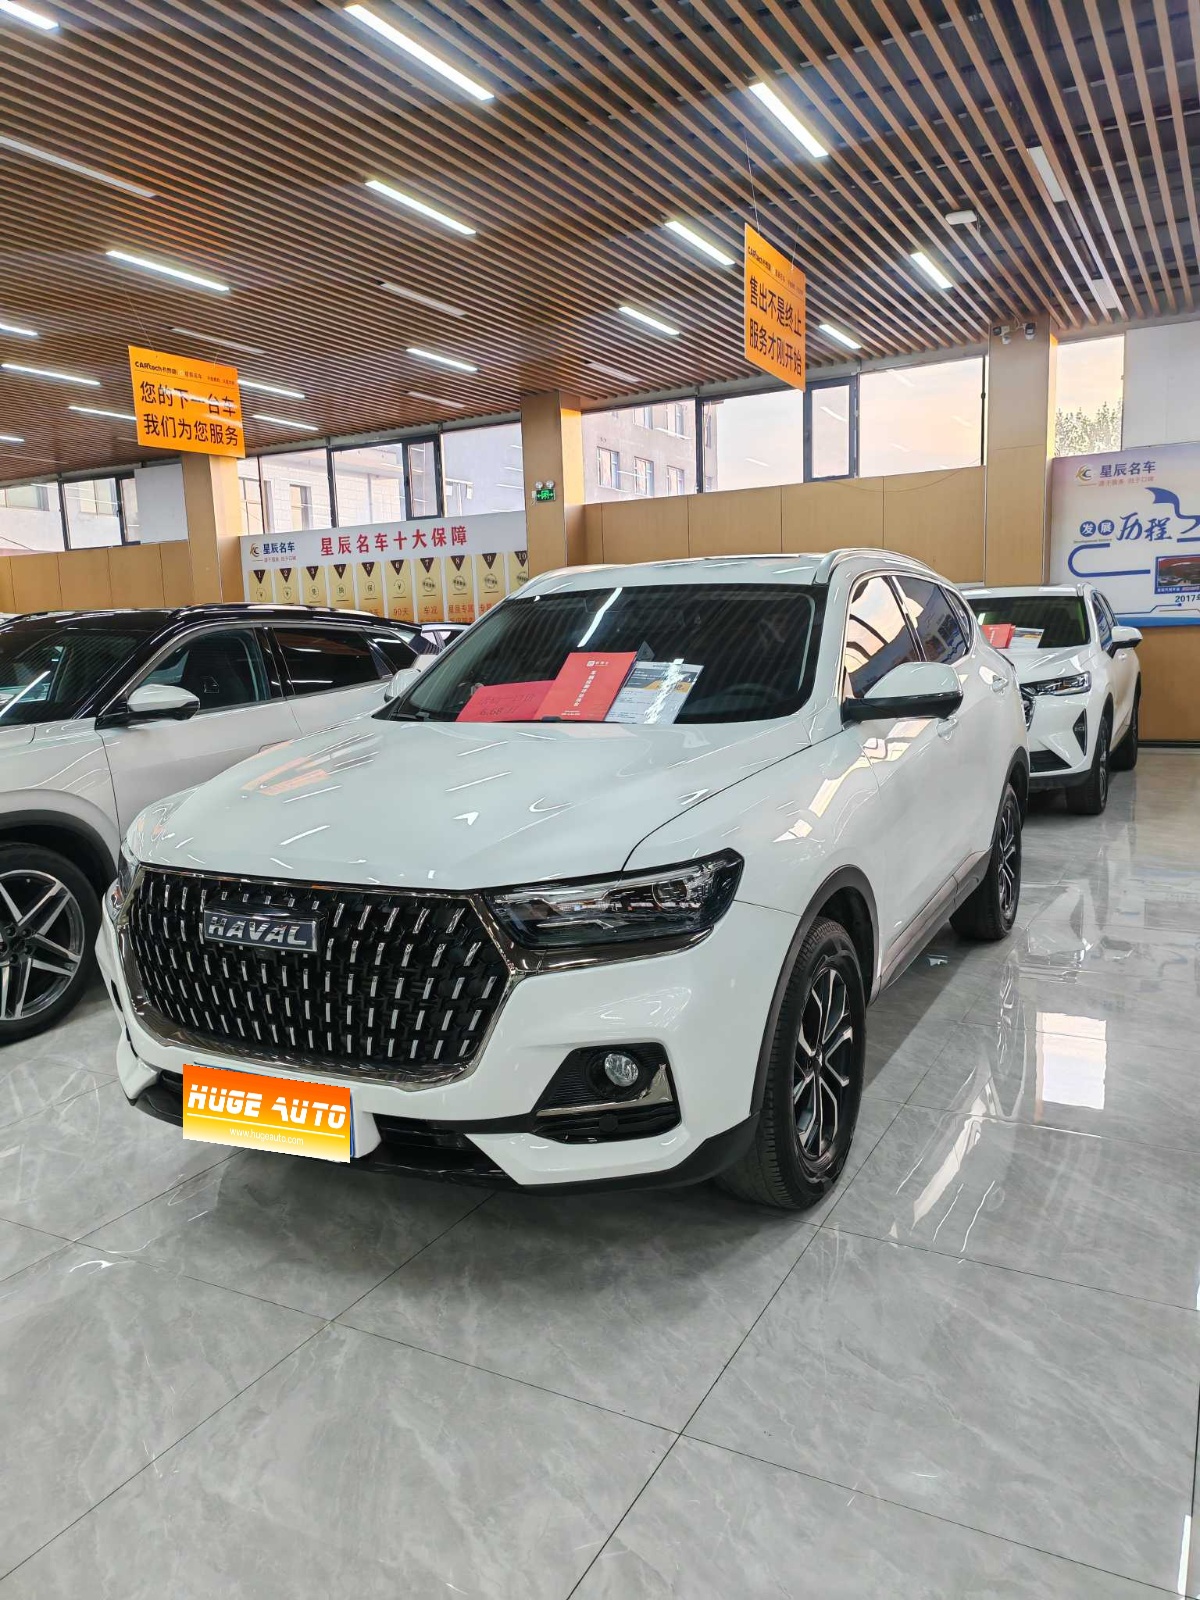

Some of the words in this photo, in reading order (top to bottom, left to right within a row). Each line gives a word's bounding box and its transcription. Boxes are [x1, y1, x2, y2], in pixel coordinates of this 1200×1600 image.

[750, 275, 802, 337] 售出不是终止
[750, 318, 802, 376] 服务才刚开始
[140, 381, 236, 417] 您的下一台车
[144, 413, 238, 446] 我们为您服务
[1100, 461, 1156, 478] 星辰名车
[263, 541, 295, 554] 星辰名车
[320, 525, 467, 556] 星辰名车十大保障
[208, 916, 307, 946] HAVAL
